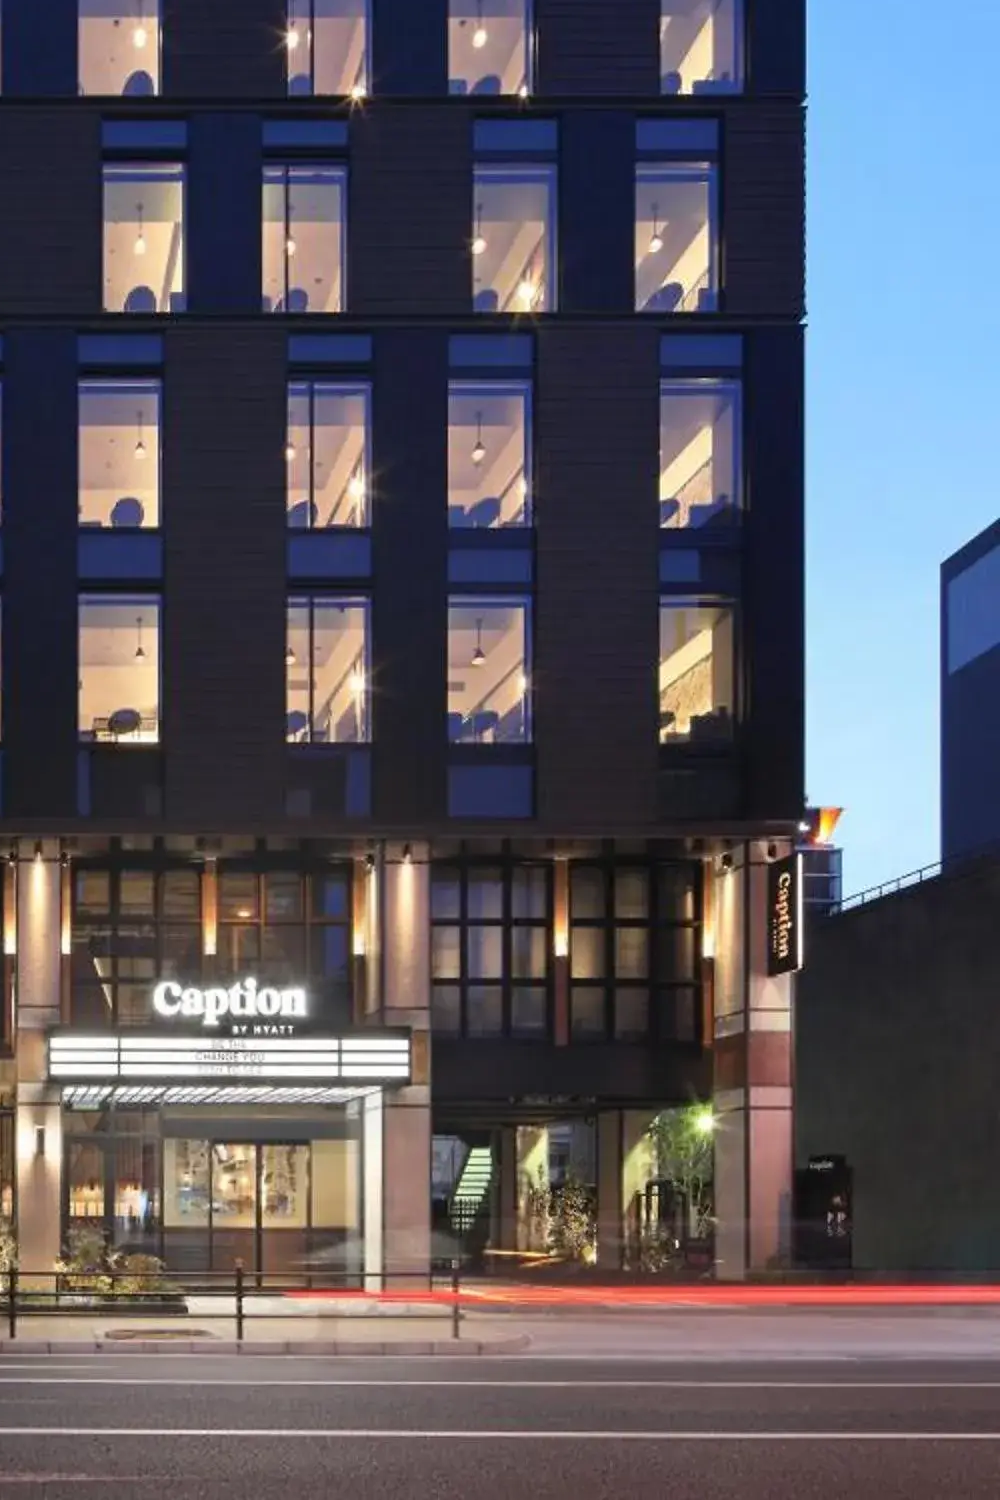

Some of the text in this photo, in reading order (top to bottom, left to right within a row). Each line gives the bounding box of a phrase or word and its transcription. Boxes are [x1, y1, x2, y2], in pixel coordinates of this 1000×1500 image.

[776, 873, 792, 959] Caption
[153, 977, 308, 1026] Caption
[232, 1025, 295, 1035] BY HYATT
[195, 1051, 265, 1062] CHANGE YOU
